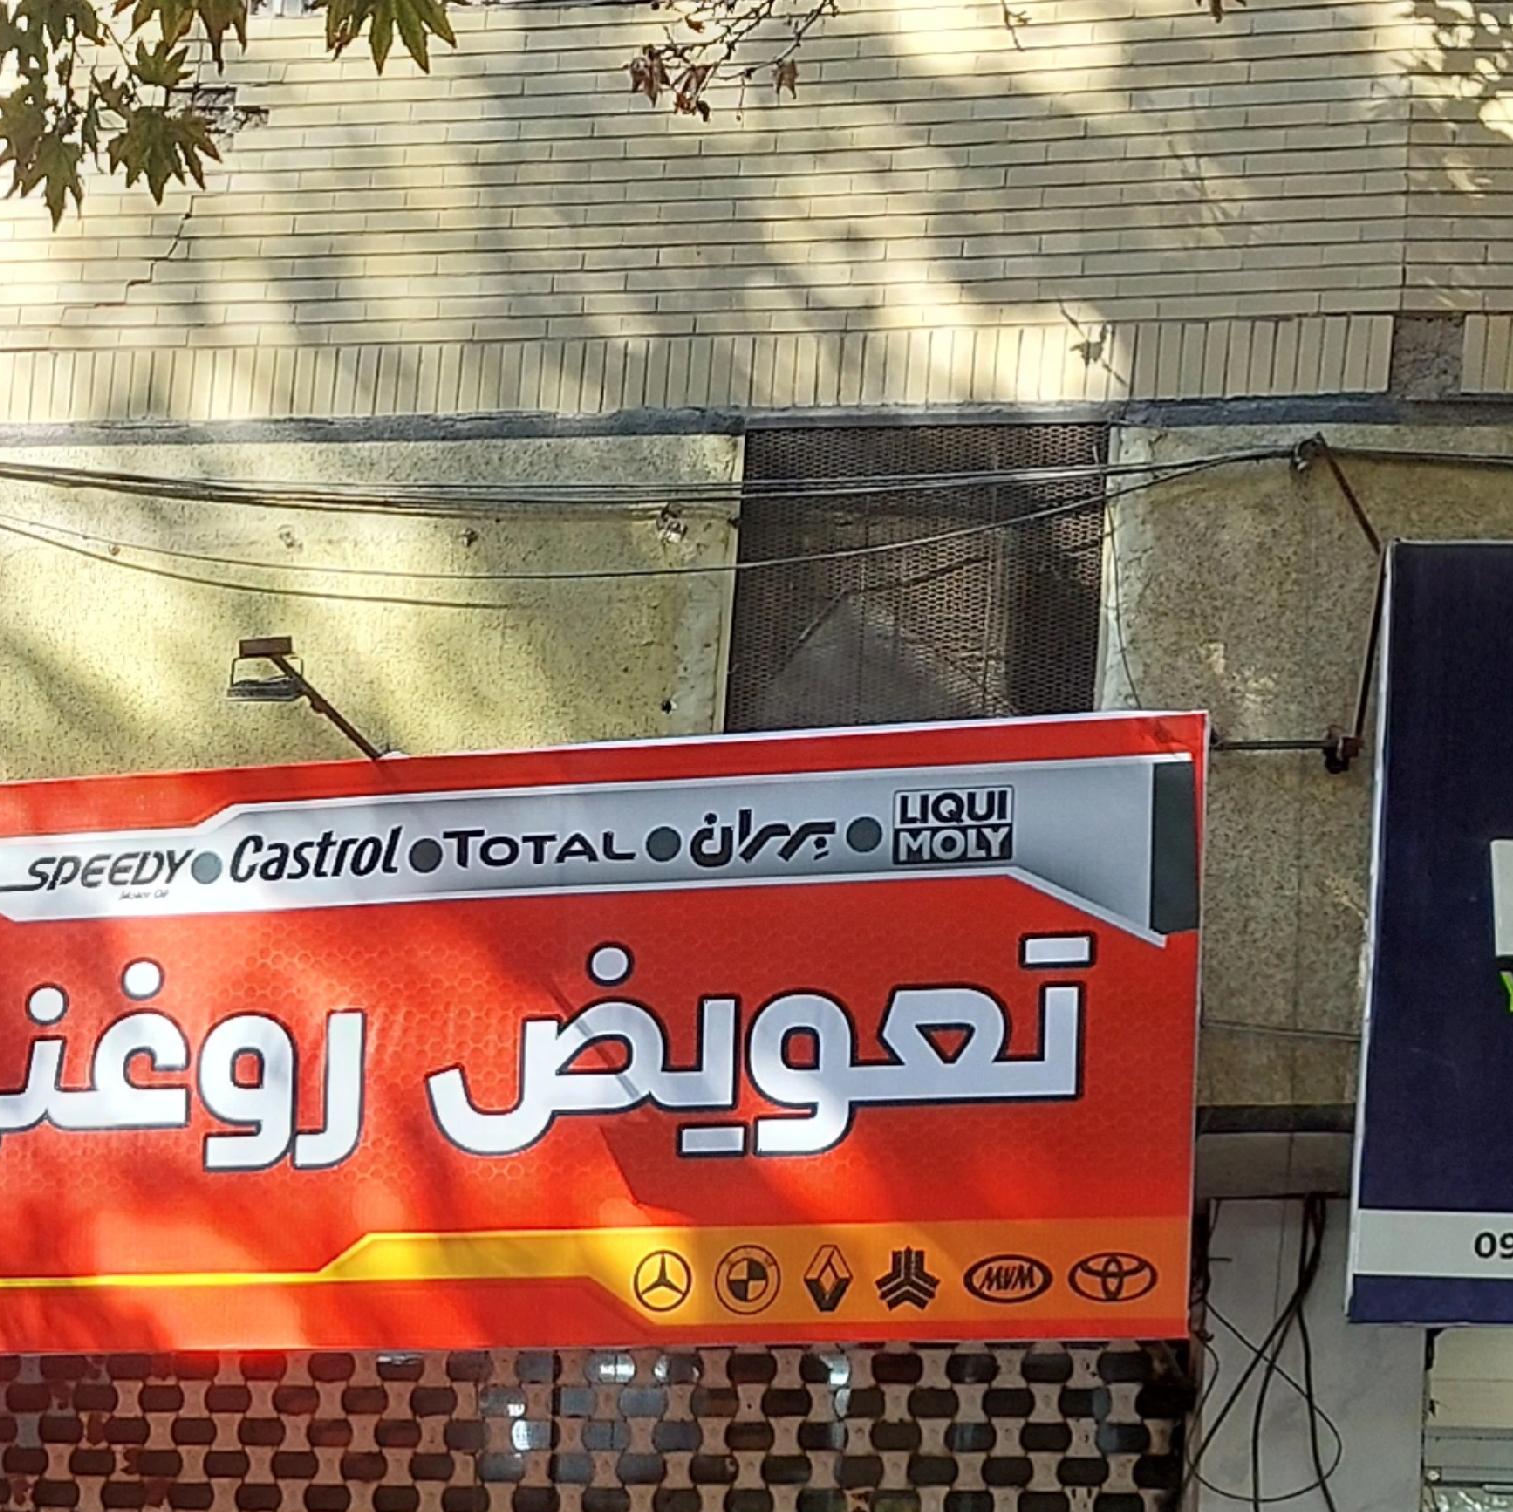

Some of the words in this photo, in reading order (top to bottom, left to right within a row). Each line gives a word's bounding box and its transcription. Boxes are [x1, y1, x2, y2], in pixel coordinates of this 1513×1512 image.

[898, 788, 1010, 824] LIQUI
[230, 825, 404, 884] Castrol
[896, 825, 1012, 862] MOLY
[426, 932, 1096, 1157] تعویض
